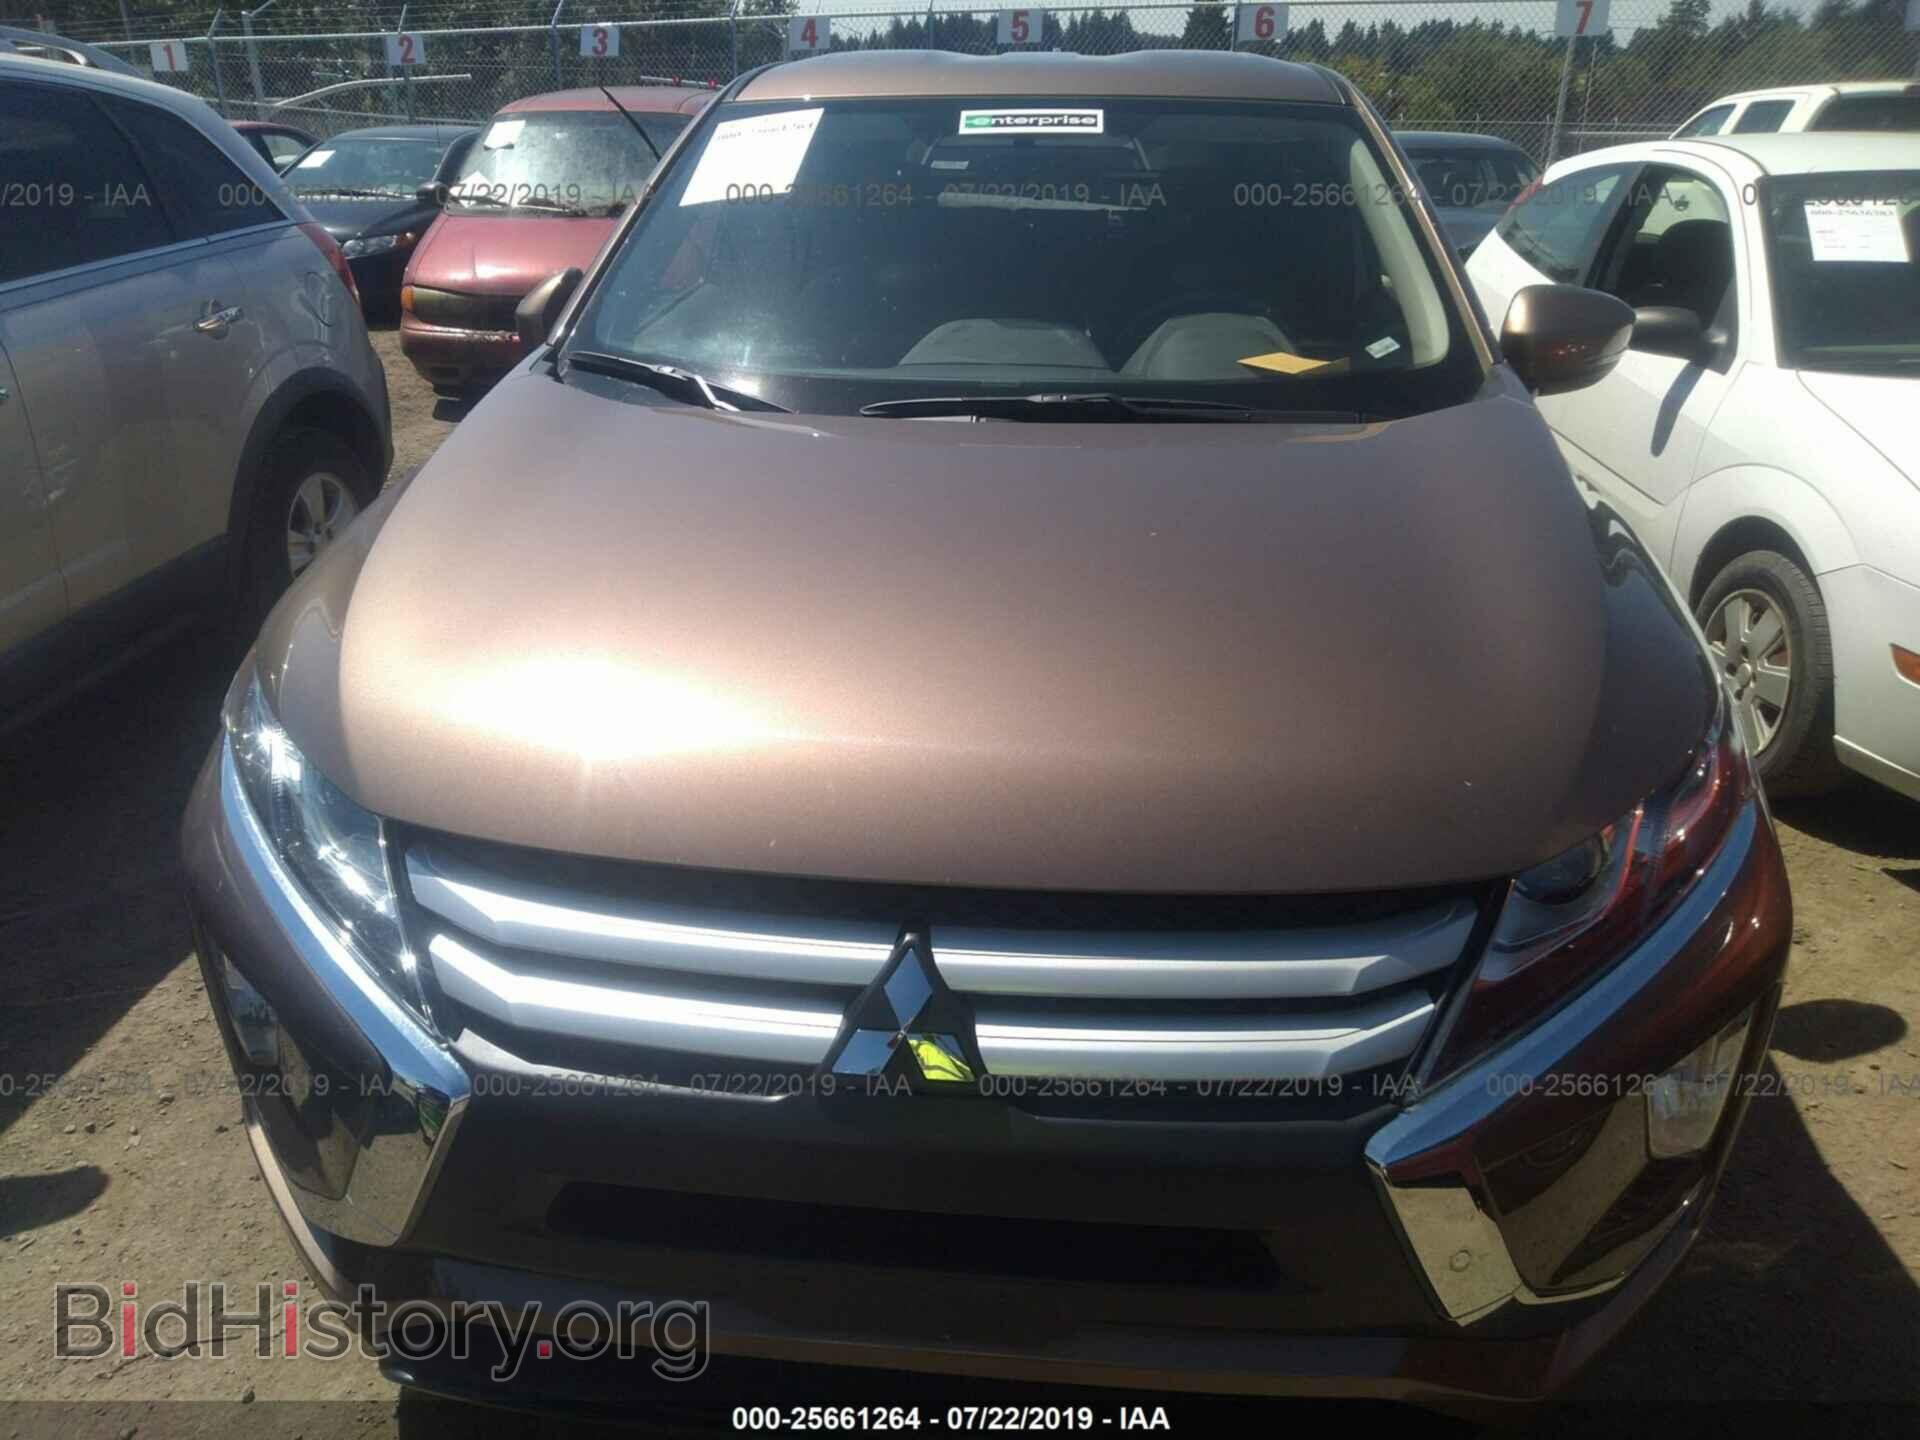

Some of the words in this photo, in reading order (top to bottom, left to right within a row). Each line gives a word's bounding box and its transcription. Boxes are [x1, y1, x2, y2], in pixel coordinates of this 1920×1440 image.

[1010, 9, 1030, 42] 5
[1254, 6, 1275, 38] 6
[1575, 0, 1595, 34] 7
[591, 28, 608, 57] 3
[800, 17, 818, 48] 4
[163, 44, 177, 72] 1
[399, 35, 416, 64] 2
[978, 114, 1096, 126] enterprise
